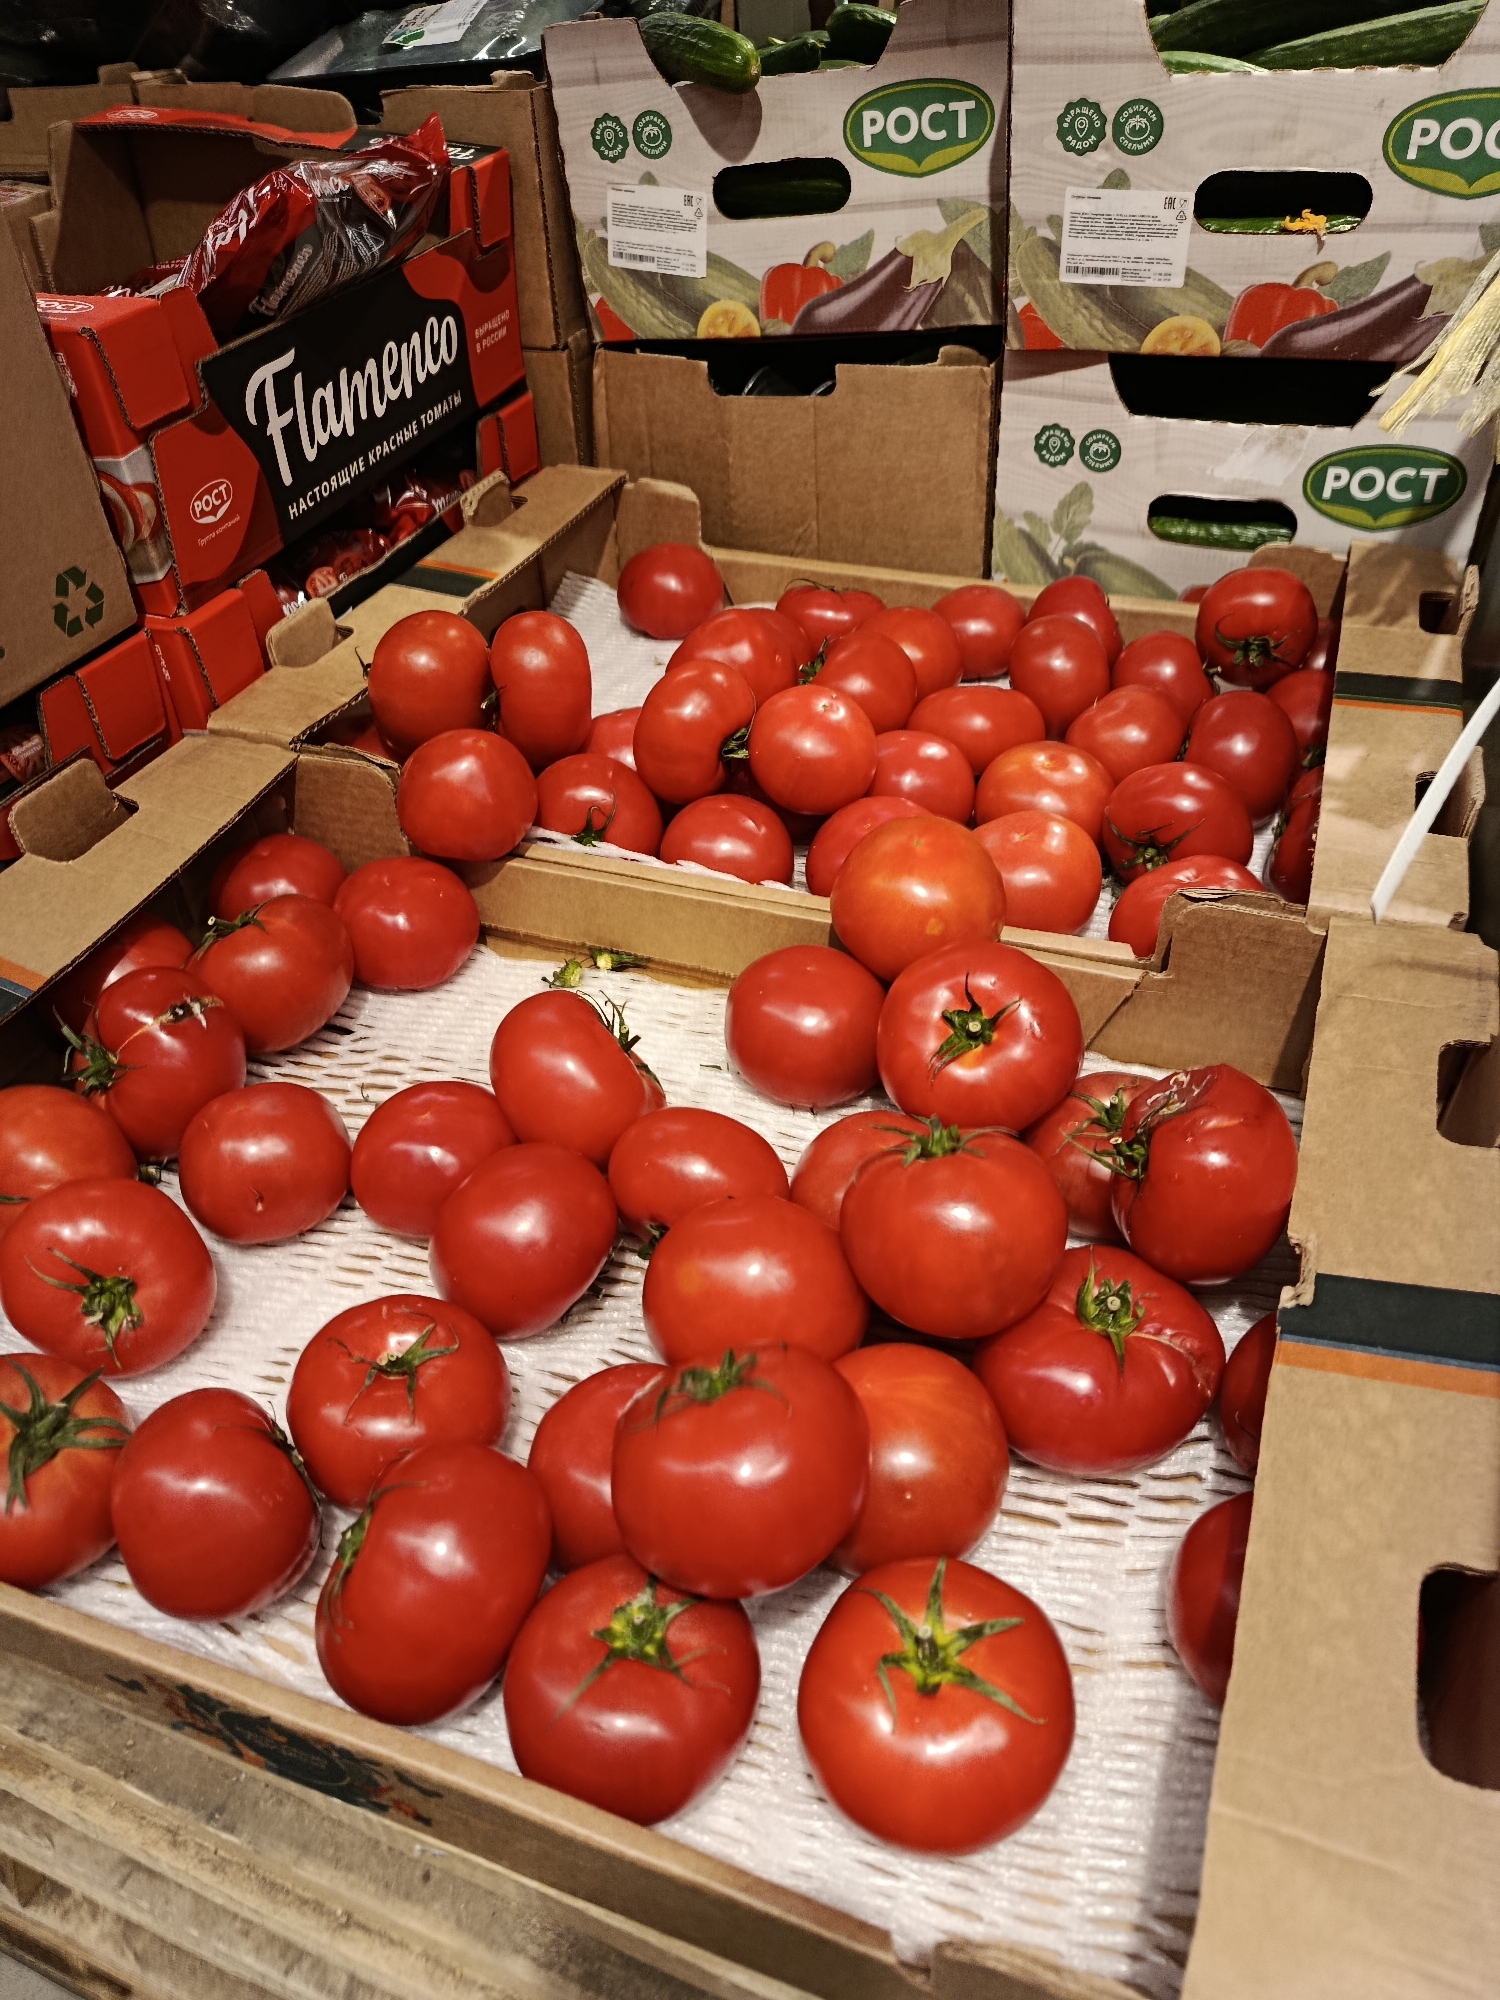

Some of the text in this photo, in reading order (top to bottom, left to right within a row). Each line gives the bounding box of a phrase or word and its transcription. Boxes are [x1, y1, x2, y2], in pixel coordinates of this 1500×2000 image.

[862, 100, 976, 148] РОСТ
[1062, 106, 1101, 128] ВЫРАЩЕНО
[1119, 104, 1158, 123] СОБИРАЕМ
[1065, 134, 1097, 150] РЯДОМ
[1119, 135, 1155, 151] СПЕЛЫМИ
[474, 309, 510, 339] ВЫРАЩЕНО
[476, 325, 507, 353] В РОССИИ
[245, 315, 458, 487] Flamenco
[288, 389, 462, 520] НАСТОЯЩИЕ КРАСНЫЕ ТОМАТЫ
[194, 482, 228, 519] РОСТ
[1321, 465, 1450, 504] РОСТ
[197, 513, 241, 547] Группа компаний
